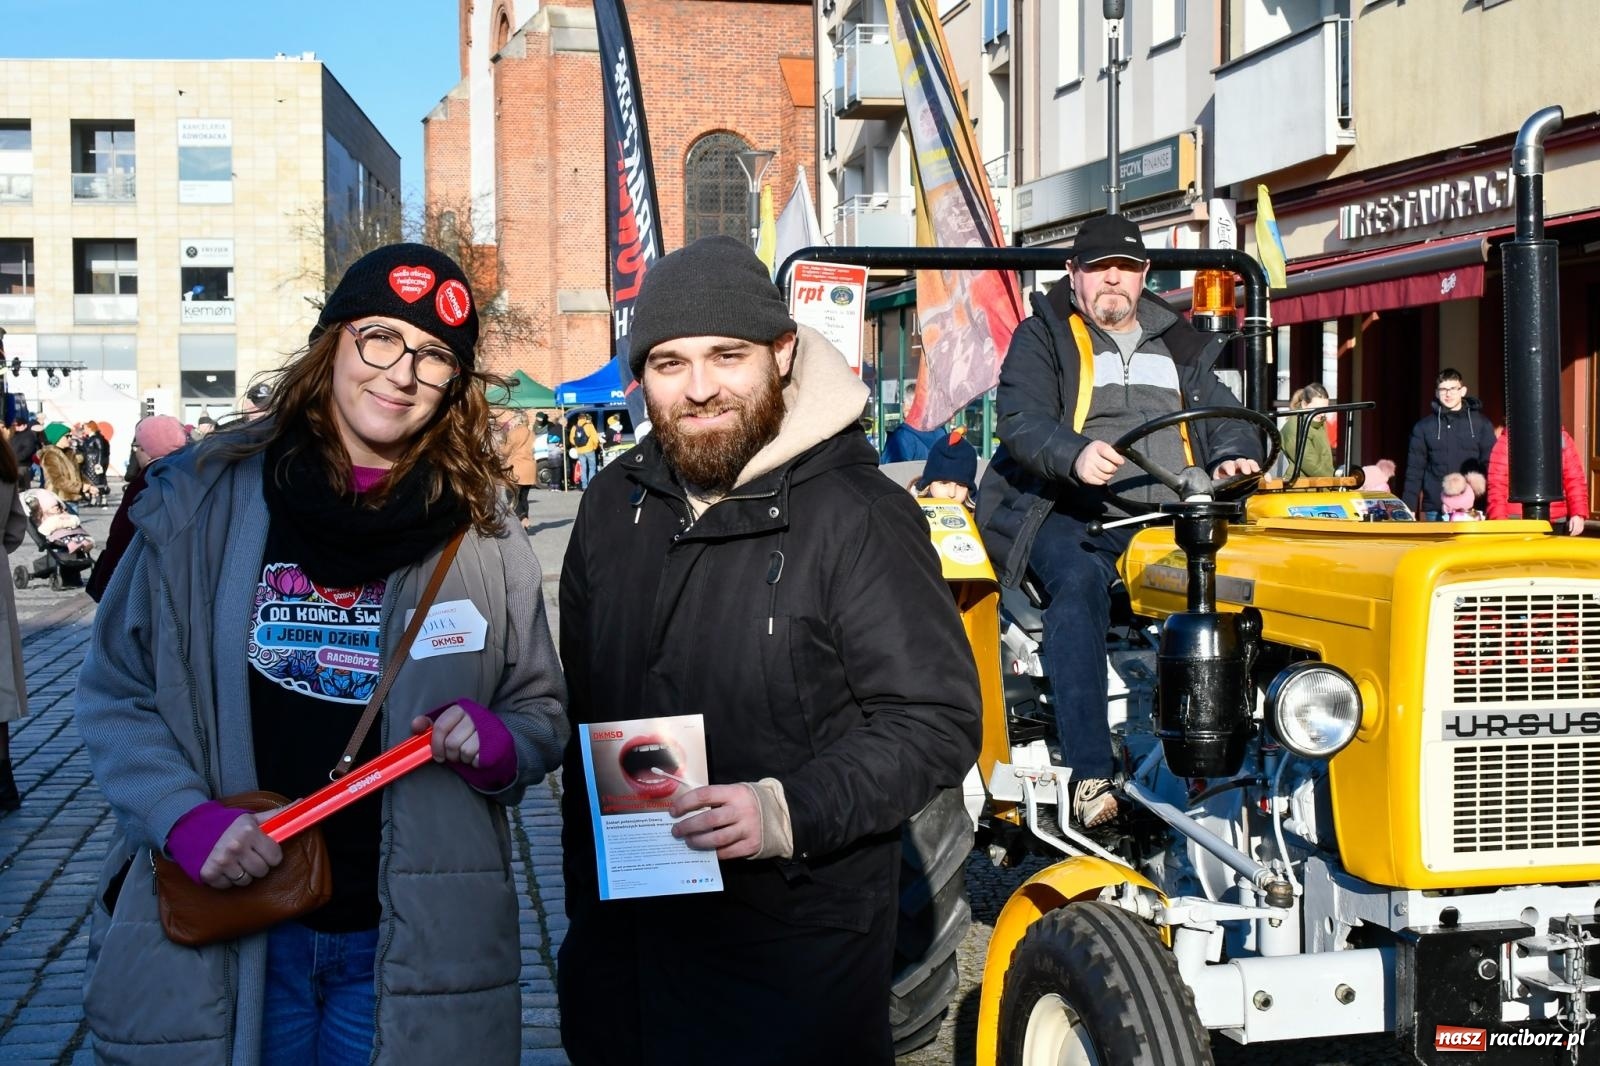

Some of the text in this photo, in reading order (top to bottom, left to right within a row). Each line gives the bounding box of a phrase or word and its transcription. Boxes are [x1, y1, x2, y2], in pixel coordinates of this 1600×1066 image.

[797, 285, 825, 304] rpt
[269, 607, 291, 621] DO
[296, 605, 350, 623] KOŃCA
[277, 627, 323, 645] JEDEN
[431, 636, 458, 648] DKMS
[1446, 711, 1600, 737] URSUS
[593, 731, 616, 740] DKMS
